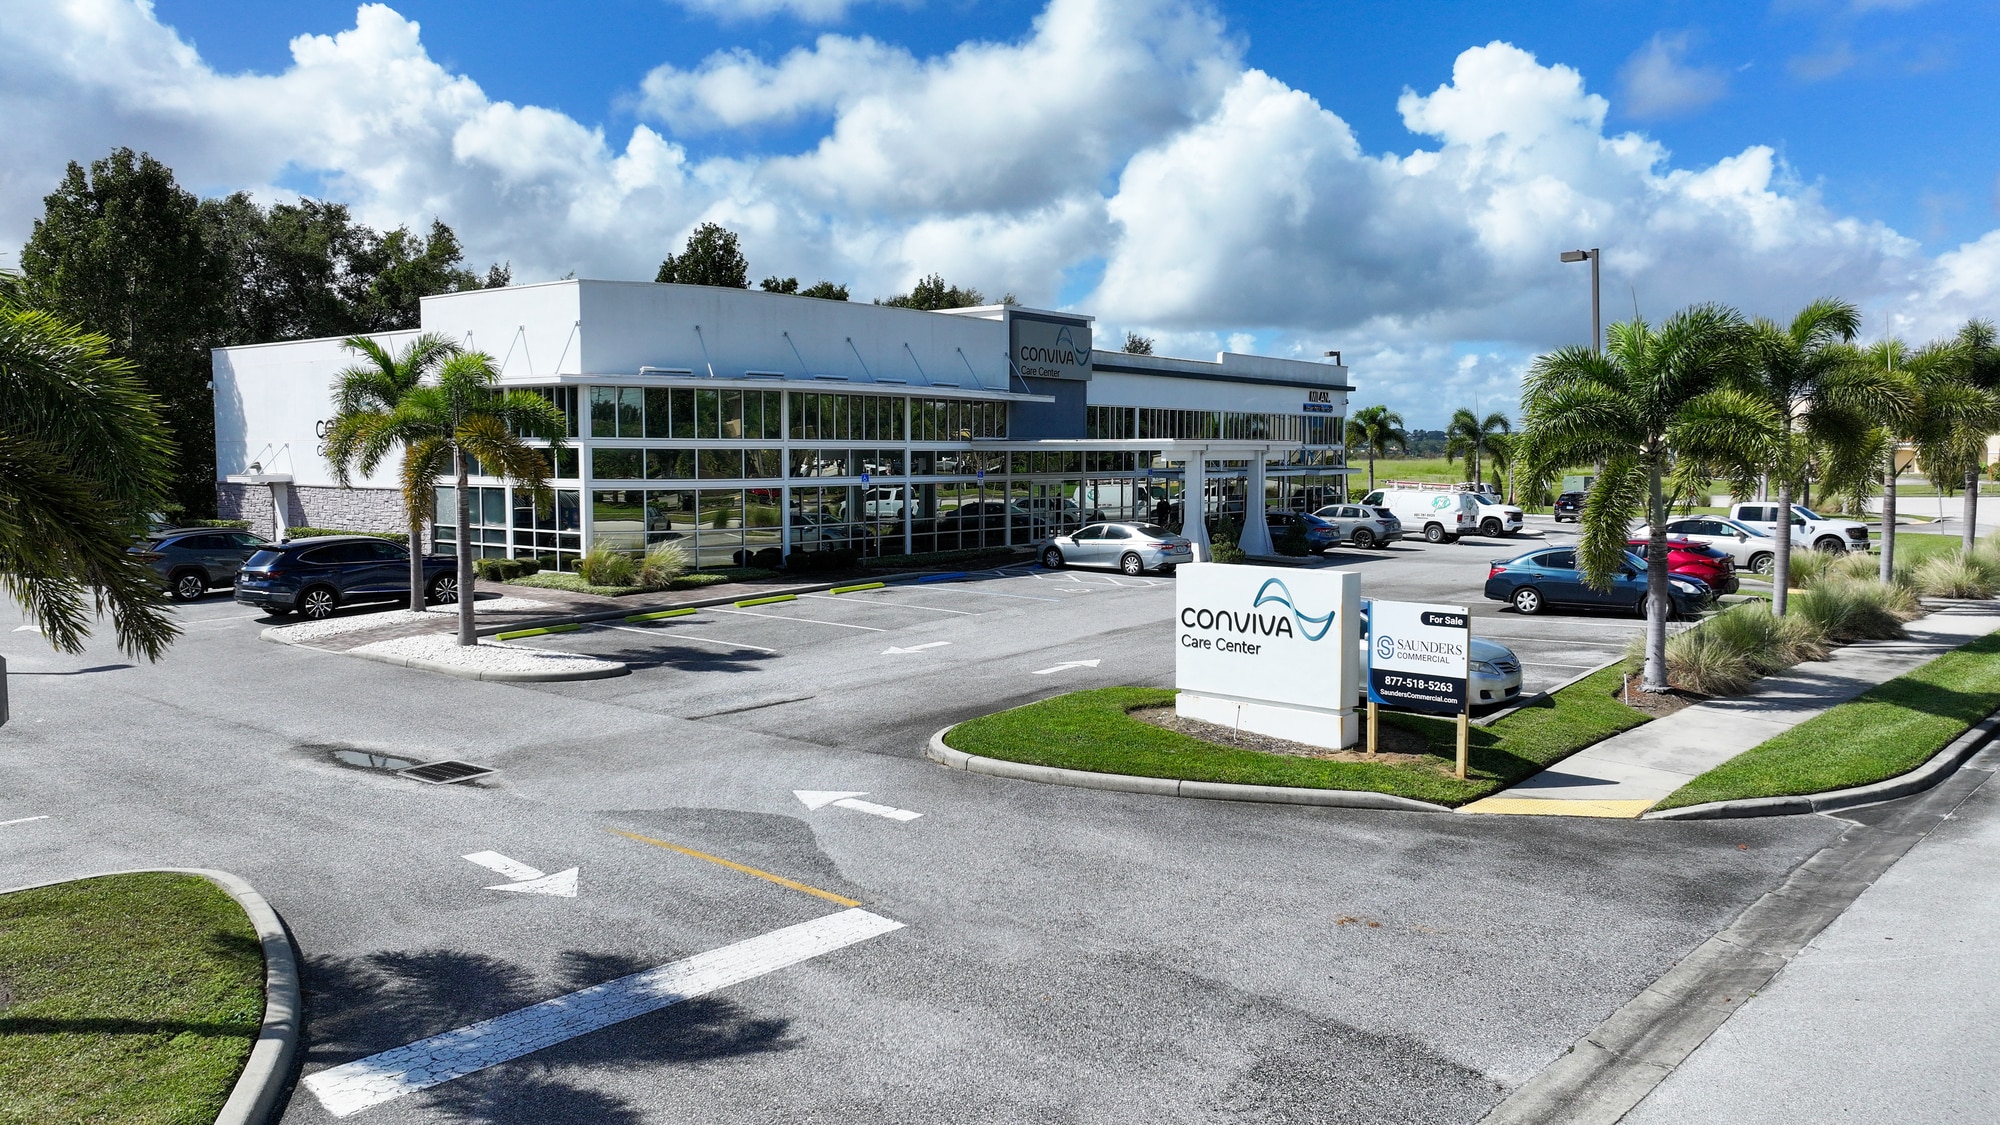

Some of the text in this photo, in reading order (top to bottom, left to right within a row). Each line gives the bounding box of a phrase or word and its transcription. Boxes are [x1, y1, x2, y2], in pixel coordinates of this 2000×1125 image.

[1021, 346, 1074, 366] CONVIVA
[1021, 365, 1061, 378] Care Center
[1181, 607, 1293, 639] CONVIVA
[1429, 615, 1463, 626] For Sale
[1181, 634, 1262, 655] Care Center
[1397, 638, 1463, 656] SAUNDERS
[1396, 651, 1450, 664] COMMERCIAL
[1384, 675, 1453, 693] 877-518-5263
[1380, 688, 1458, 704] SaundersCommercial.com
